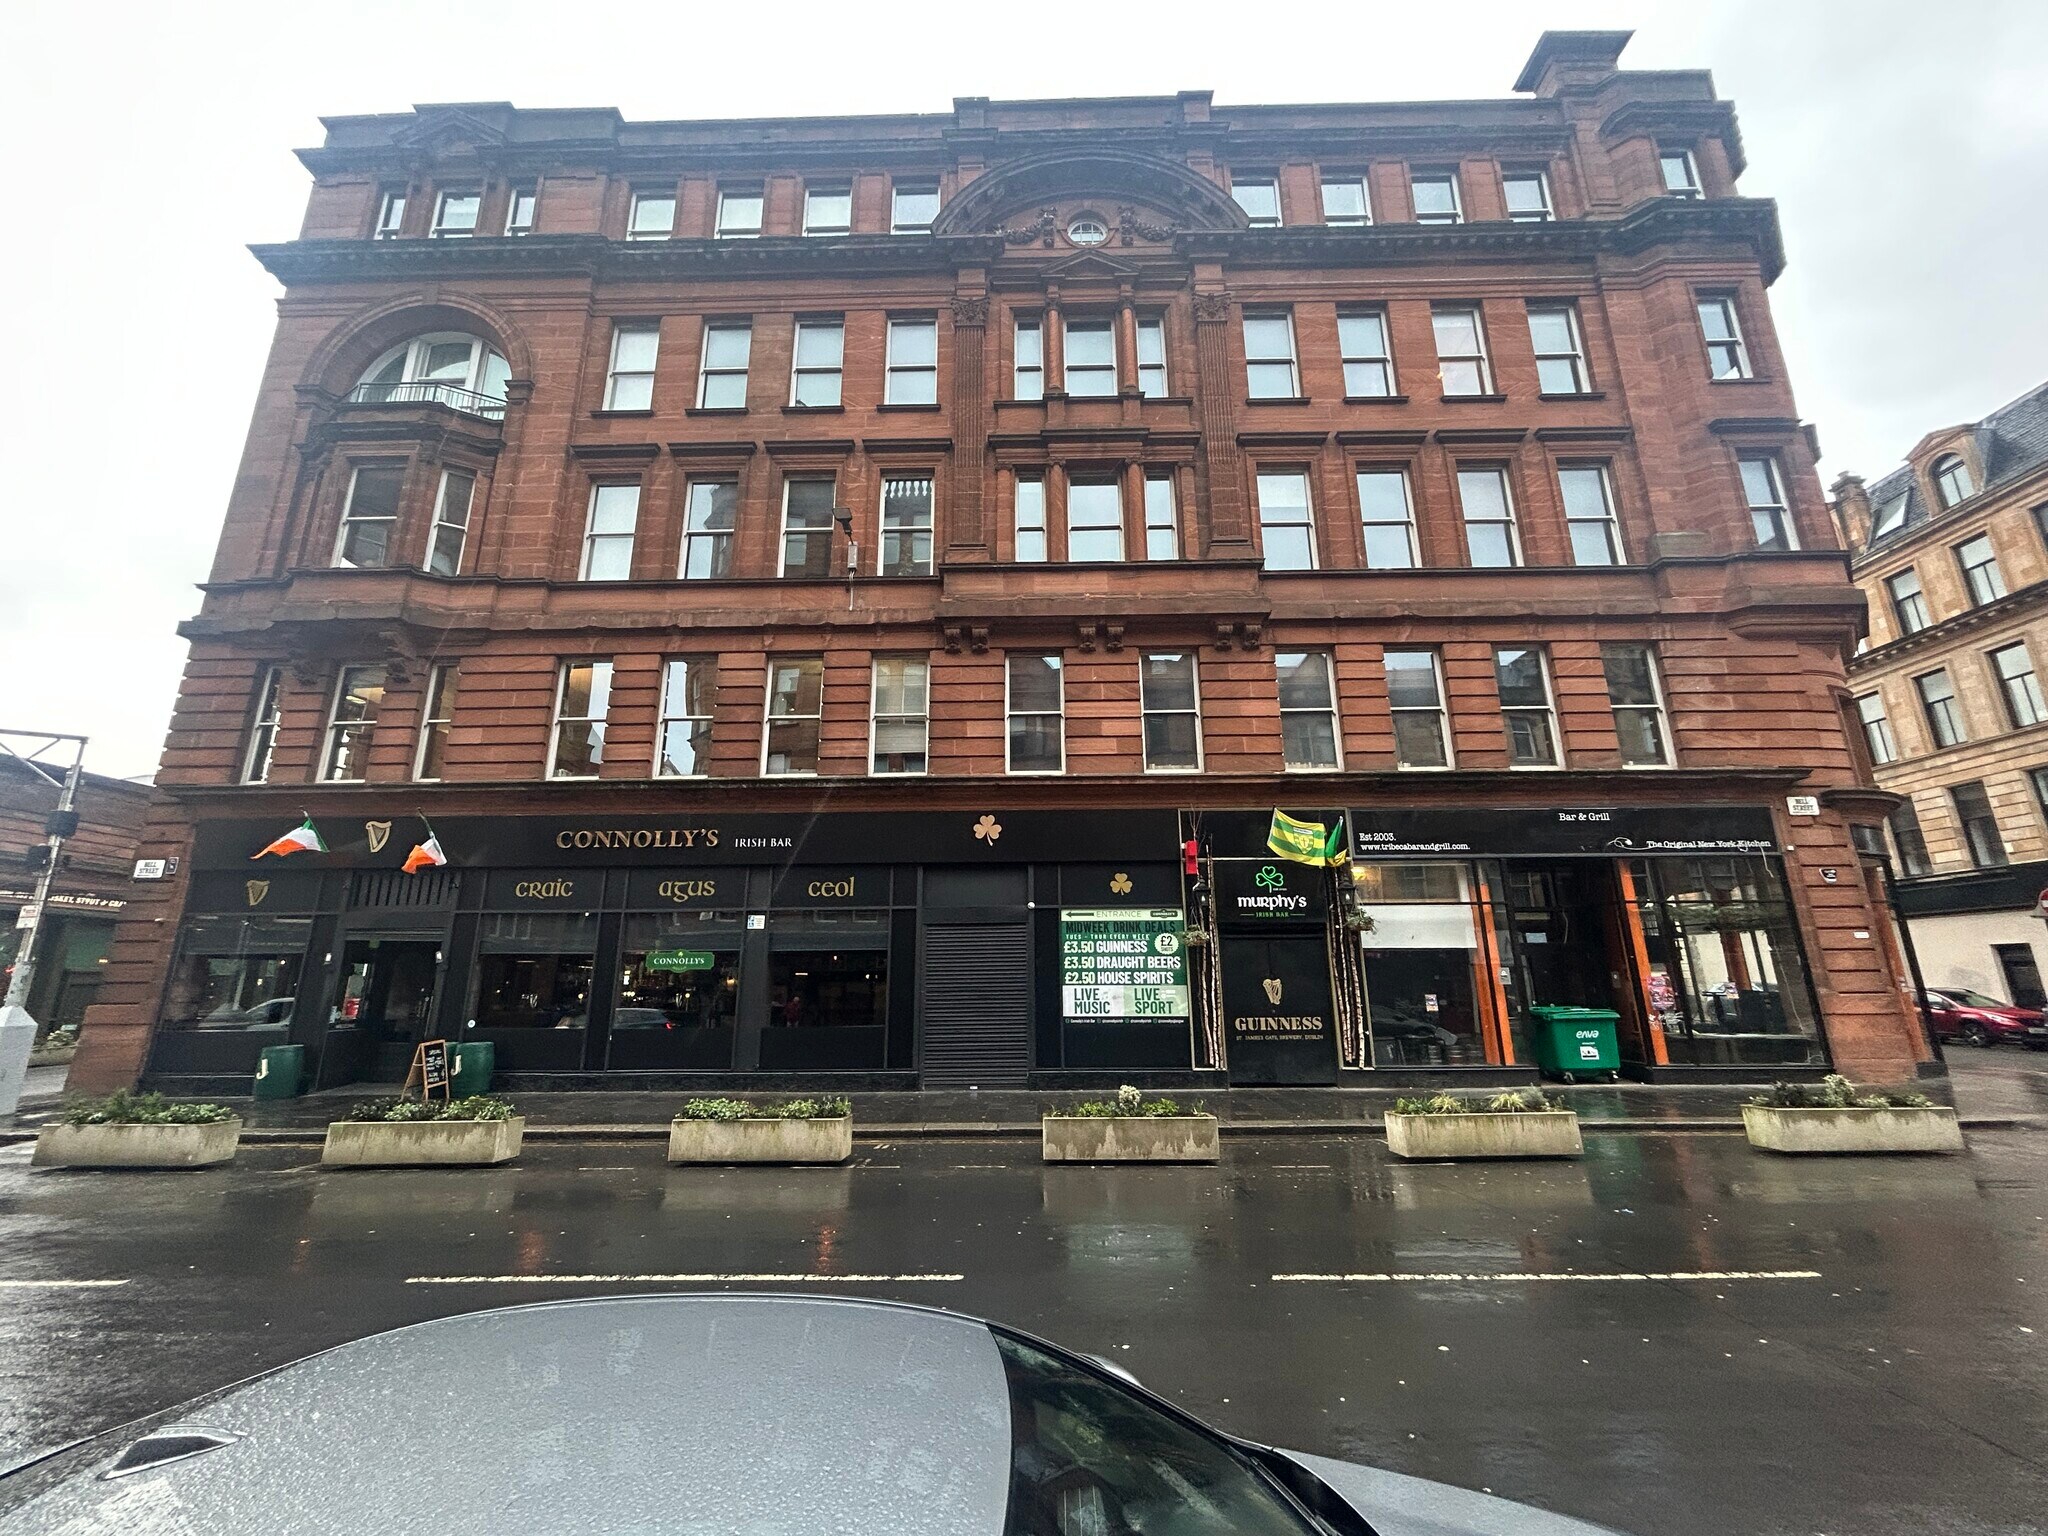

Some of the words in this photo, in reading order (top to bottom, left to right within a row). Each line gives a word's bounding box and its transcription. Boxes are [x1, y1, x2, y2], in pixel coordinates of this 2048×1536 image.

[1559, 813, 1577, 821] Bar
[1578, 813, 1587, 821] &
[1588, 812, 1610, 821] Grill
[556, 829, 719, 849] CONNOLLY'S
[735, 838, 766, 848] IRISH
[770, 837, 792, 848] BAR
[1359, 833, 1373, 841] Est
[1374, 833, 1396, 841] 2003.
[1360, 843, 1471, 852] www.tribecabarandgrill.com.
[1663, 840, 1697, 849] Original
[1716, 840, 1736, 848] York
[1737, 840, 1771, 848] Kitchen
[658, 880, 716, 903] agus
[808, 876, 855, 897] ceol
[1237, 895, 1308, 910] murphy's
[1065, 921, 1109, 933] MIDWEEK
[1113, 921, 1142, 933] DRINK
[1145, 921, 1176, 933] DEALS
[1160, 935, 1173, 946] £2
[1064, 941, 1094, 953] £3.50
[1096, 941, 1148, 953] GUINNESS
[653, 957, 705, 965] CONNOLLY'S
[1064, 956, 1095, 969] £3.50
[1097, 956, 1146, 969] DRAUGHT
[1147, 956, 1181, 969] BEERS
[1065, 972, 1095, 984] £2.50
[1097, 972, 1131, 984] HOUSE
[1133, 972, 1174, 984] SPIRITS
[1074, 988, 1100, 1000] LIVE
[1134, 988, 1160, 1000] LIVE
[1074, 1001, 1111, 1014] MUSIC
[1135, 1001, 1174, 1014] SPORT
[1234, 1017, 1323, 1031] GUINNESS
[1576, 1030, 1599, 1039] enva
